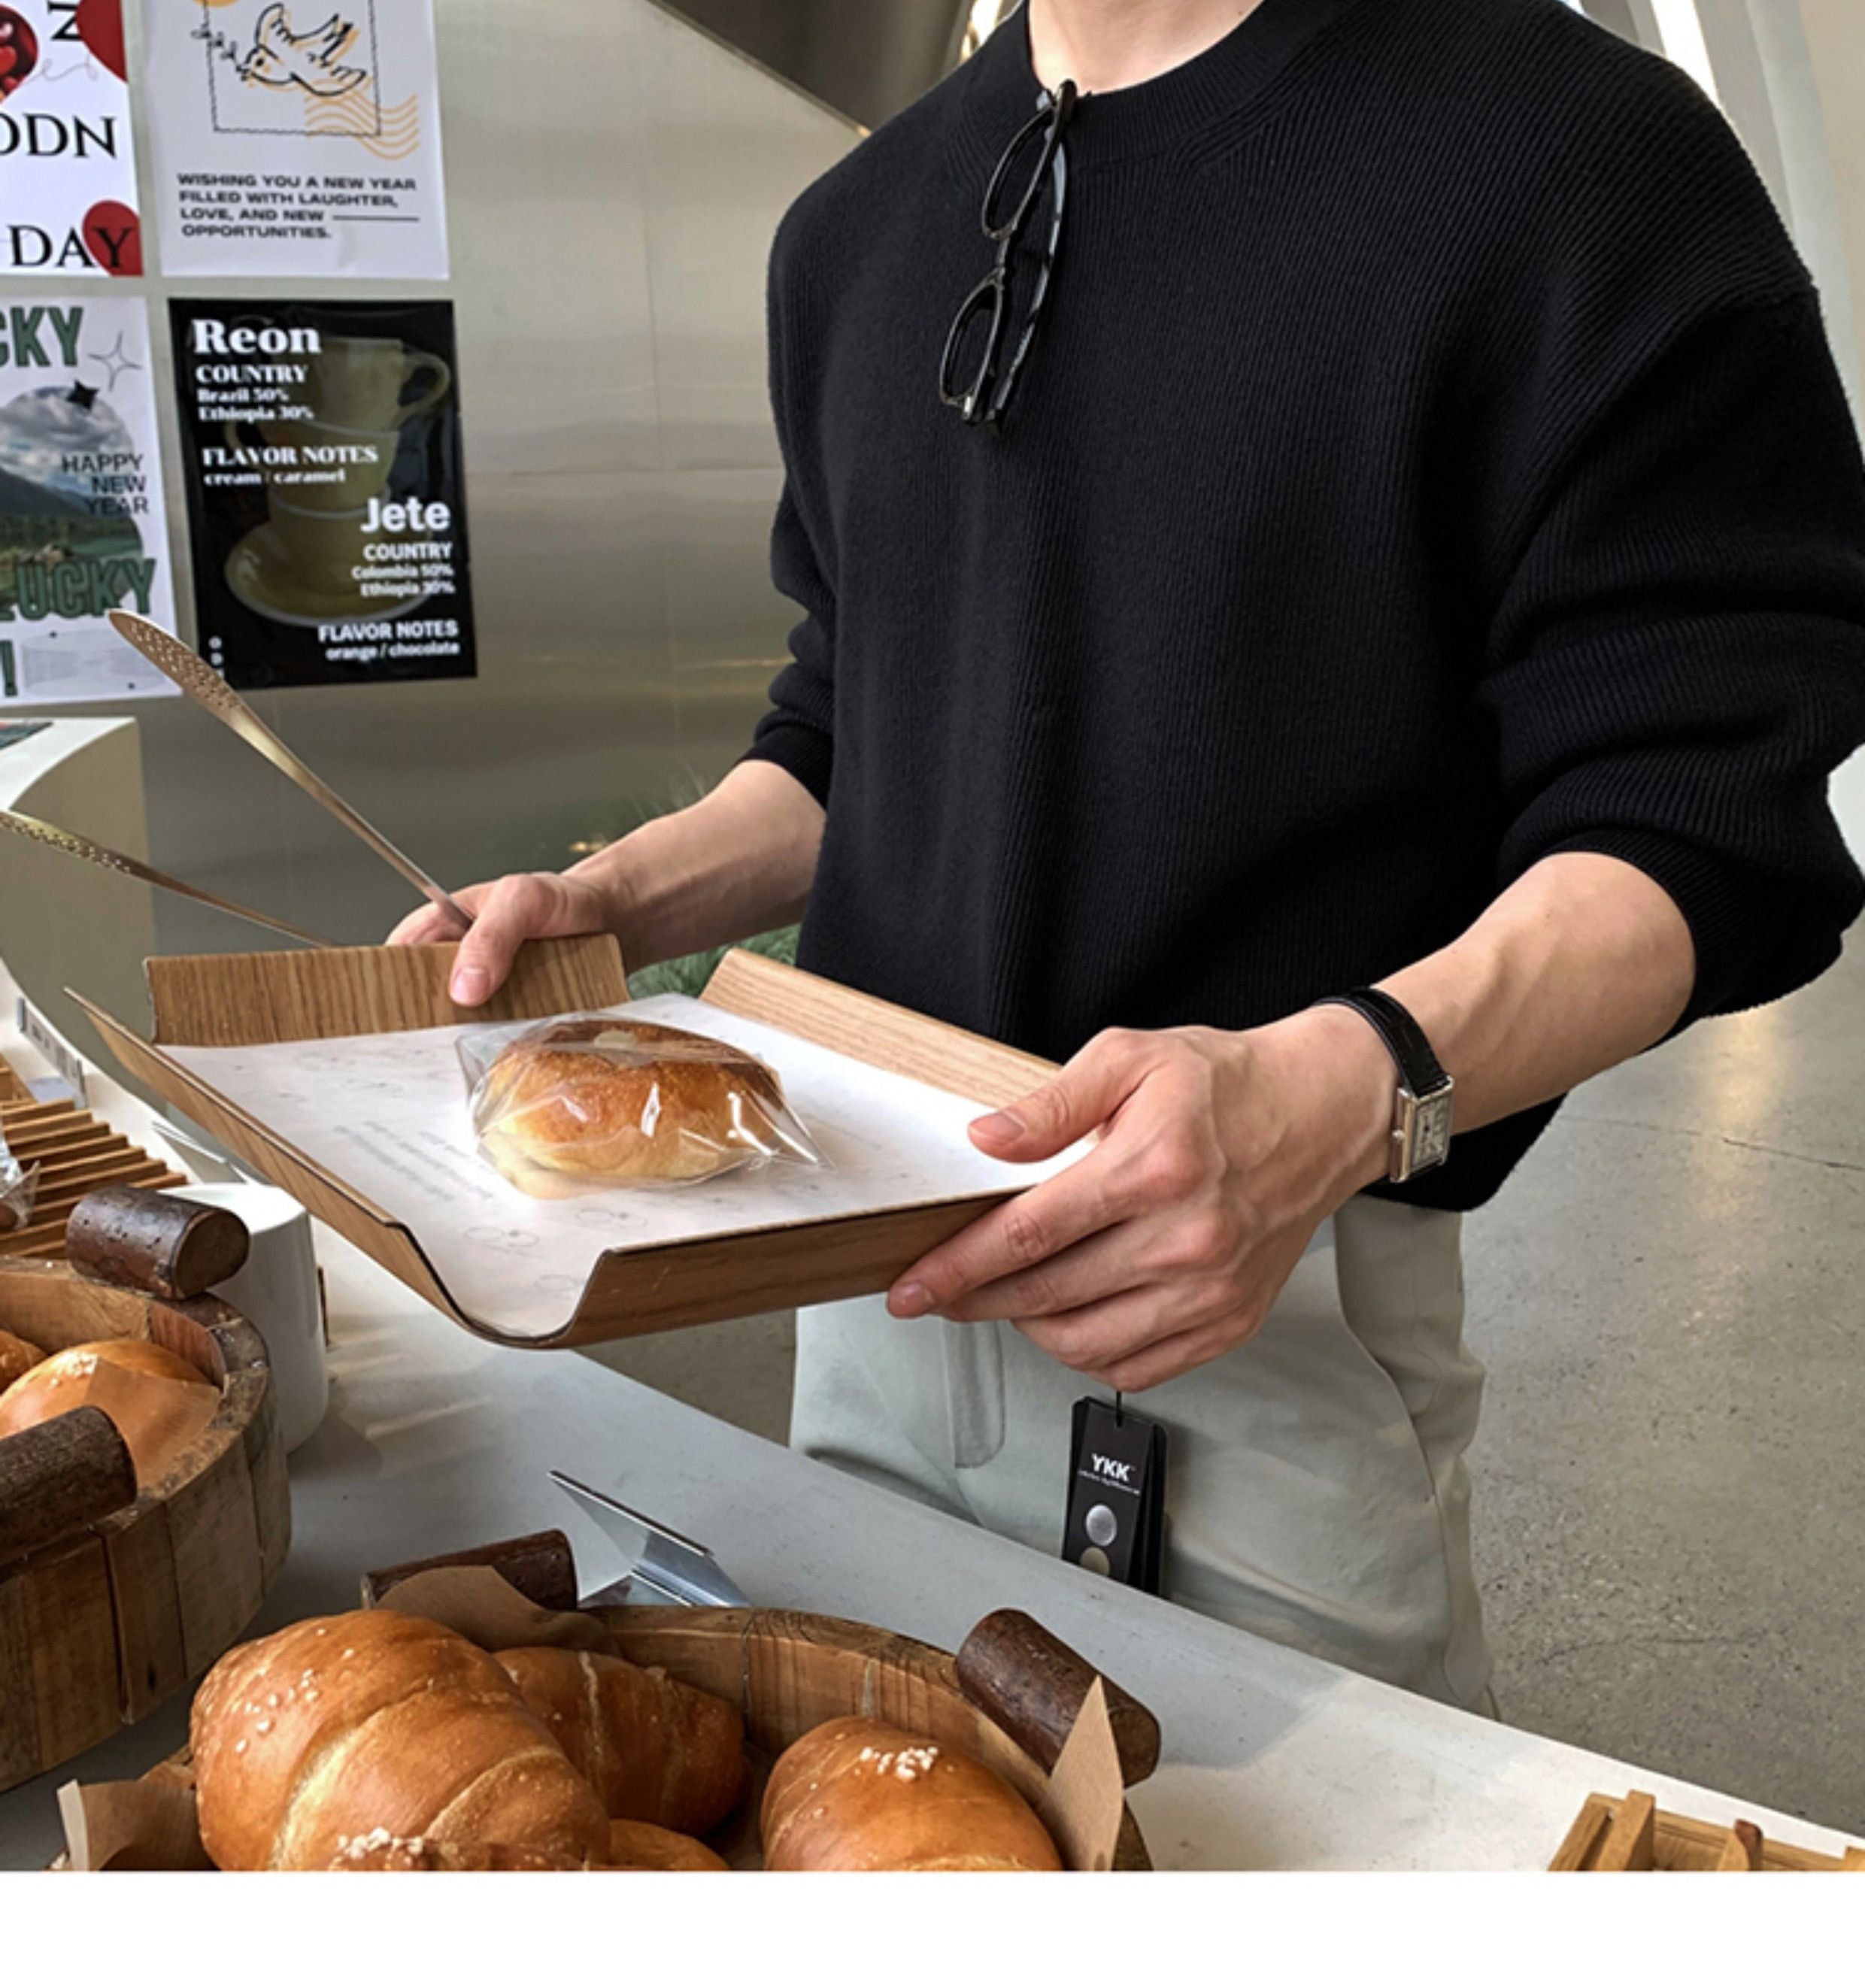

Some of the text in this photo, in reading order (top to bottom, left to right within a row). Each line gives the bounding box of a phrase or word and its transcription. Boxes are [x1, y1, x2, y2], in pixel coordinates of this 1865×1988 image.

[177, 173, 417, 190] WISHING YOU A NEW YEAR
[179, 191, 398, 208] FILLED WITH LAUGHTER,
[180, 208, 324, 221] LOVE, AND NEW
[181, 226, 331, 238] OPPORTUNITIES.
[10, 224, 132, 268] DAY
[191, 319, 322, 354] Reon
[196, 364, 308, 383] COUNTRY
[197, 387, 250, 402] Brazil
[199, 406, 275, 423] Ethiopia
[61, 453, 144, 473] HAPPY
[202, 446, 378, 466] FLAVOR NOTES
[90, 475, 147, 494] NEW
[203, 471, 262, 486] cream
[273, 468, 346, 483] caramel
[85, 496, 149, 515] YEAR
[359, 496, 450, 532] Jete
[362, 542, 453, 562] COUNTRY
[350, 563, 419, 580] Colombia
[359, 580, 420, 598] Ethiopia
[317, 620, 459, 643] FLAVOR NOTES
[325, 646, 378, 662] orange
[389, 641, 460, 658] chocolate
[1091, 1453, 1131, 1483] YKK
